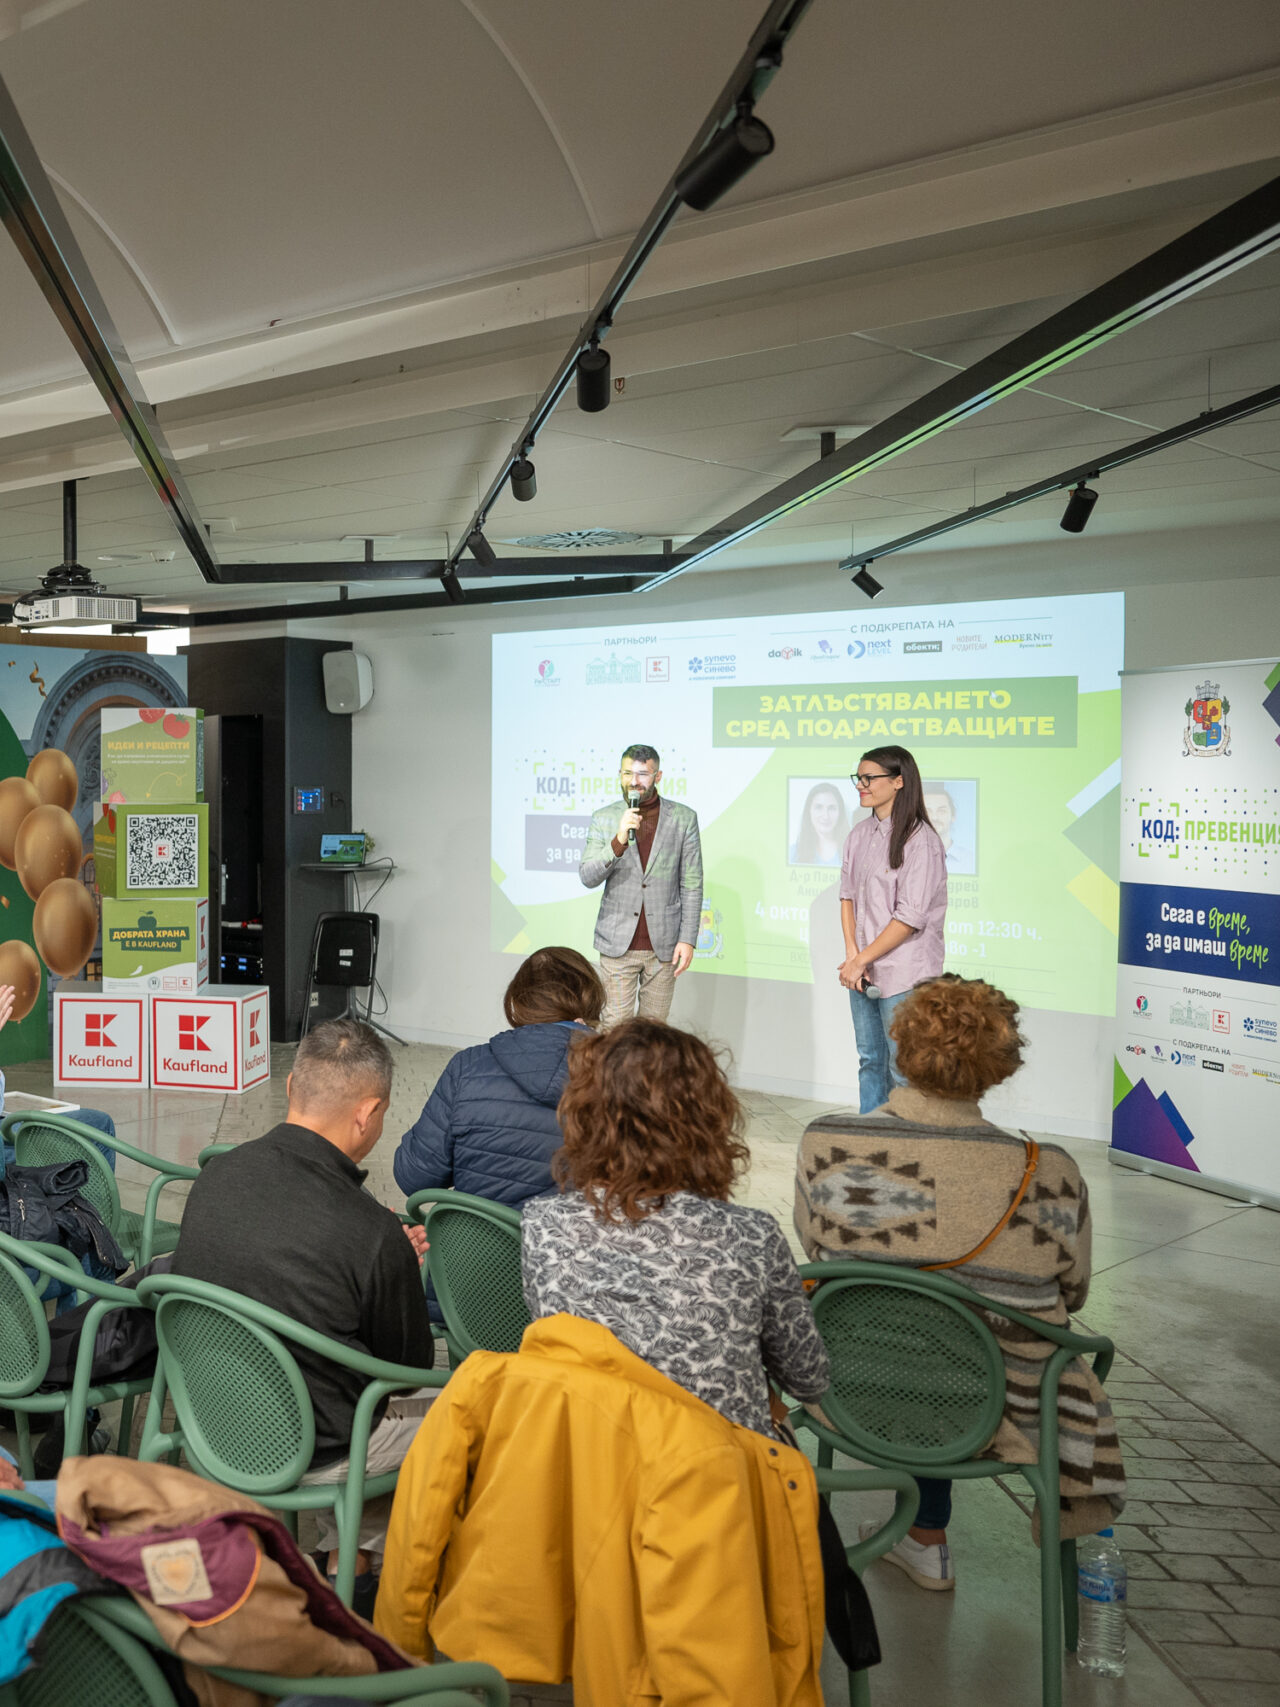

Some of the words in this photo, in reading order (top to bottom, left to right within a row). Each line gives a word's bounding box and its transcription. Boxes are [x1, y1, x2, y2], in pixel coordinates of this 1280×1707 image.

[861, 620, 934, 633] ПОДКРЕПАТА
[938, 619, 955, 629] НА
[604, 635, 657, 647] ПАРТНЬОРИ
[868, 638, 892, 648] next
[759, 690, 1012, 713] ЗАТЛЪСТЯВАНЕТО
[726, 720, 790, 740] СРЕД
[797, 716, 1056, 739] ПОДРАСТВАЩИТЕ
[107, 741, 135, 752] ИДЕИ
[136, 741, 144, 750] И
[146, 741, 190, 751] РЕЦЕПТИ
[536, 776, 576, 798] КОД:
[1141, 819, 1180, 843] КОД:
[1184, 820, 1280, 847] ПРЕВЕНЦИ
[754, 900, 765, 920] 4
[977, 920, 1023, 940] 12:30
[1161, 902, 1194, 925] Сега
[1197, 909, 1206, 926] е
[112, 930, 155, 940] ДОБРАТА
[156, 929, 187, 938] ХРАНА
[138, 940, 177, 949] KAUFLAND
[1145, 932, 1162, 952] За
[1164, 934, 1181, 954] да
[1183, 936, 1227, 956] имаш
[1182, 986, 1222, 999] ПАРТНЬОРИ
[1178, 1040, 1220, 1054] ПОДКРЕПАТА
[68, 1054, 133, 1068] Kaufland
[162, 1057, 228, 1074] Kaufland
[244, 1051, 266, 1073] Kaufland
